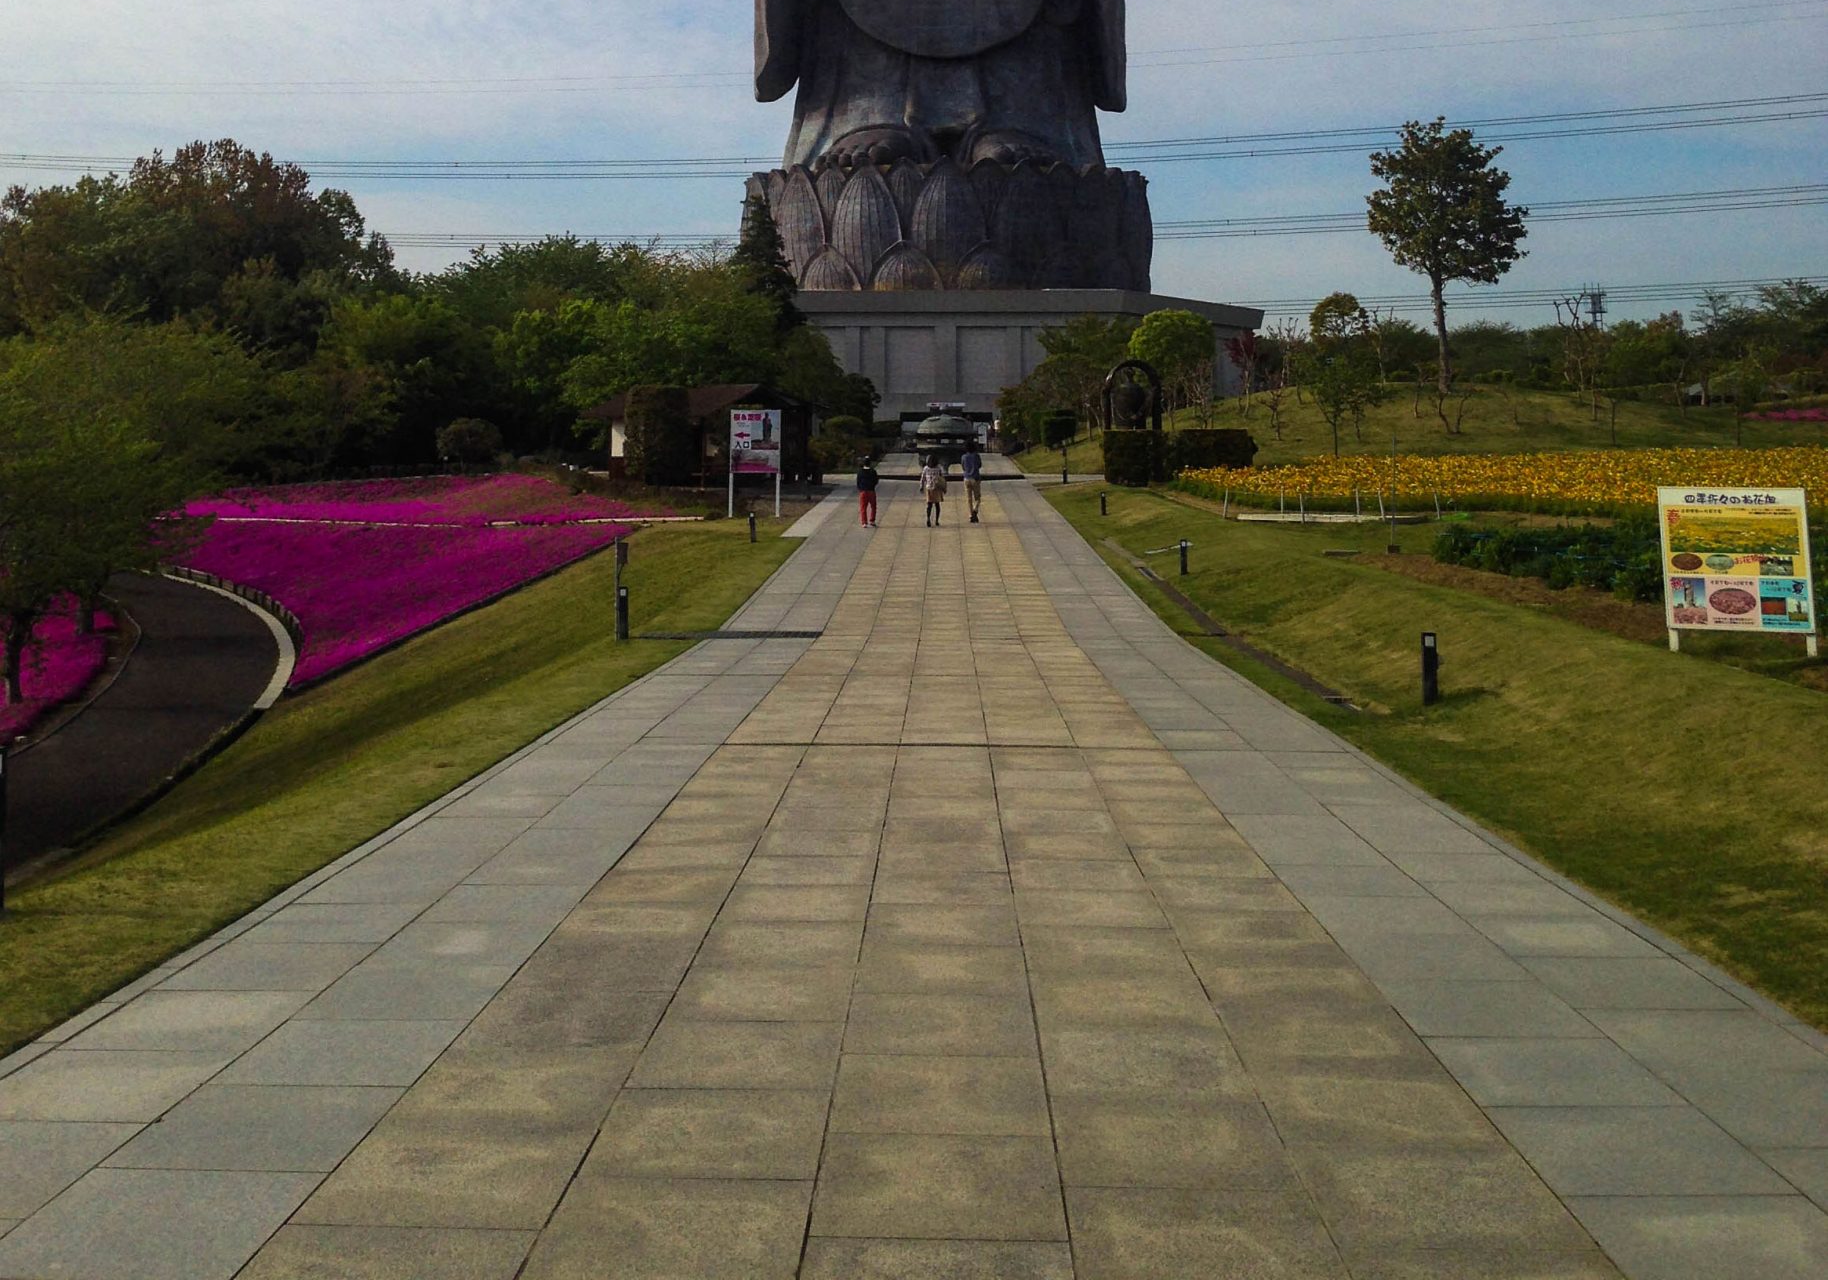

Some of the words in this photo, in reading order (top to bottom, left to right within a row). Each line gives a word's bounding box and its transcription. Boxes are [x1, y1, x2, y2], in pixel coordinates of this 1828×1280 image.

[735, 441, 750, 449] 入口
[1684, 493, 1777, 505] 四季折々のお花畑
[1667, 509, 1680, 524] 春
